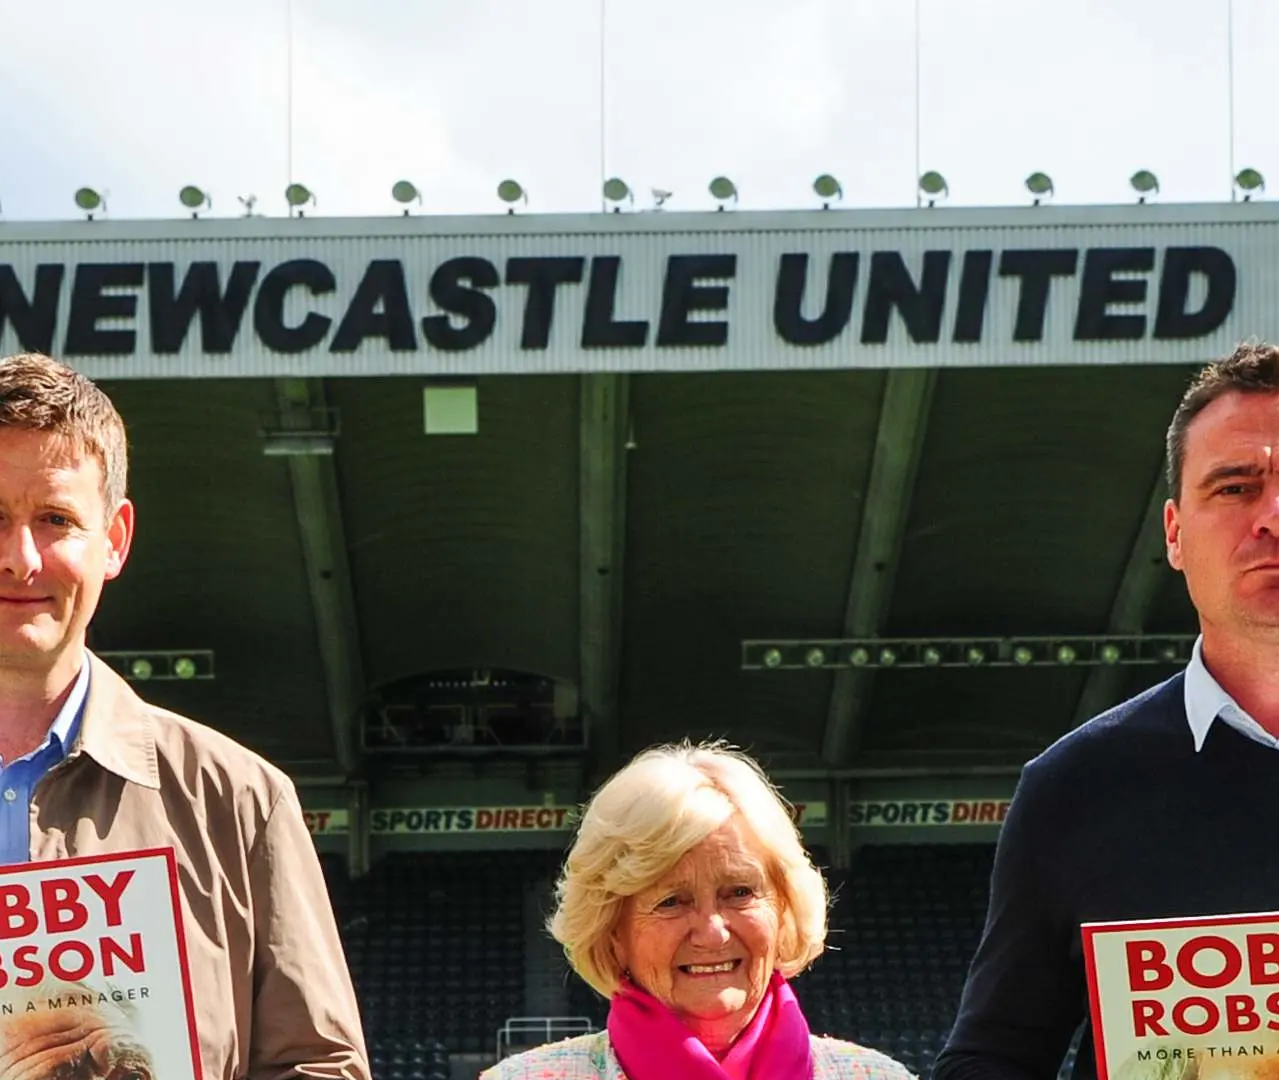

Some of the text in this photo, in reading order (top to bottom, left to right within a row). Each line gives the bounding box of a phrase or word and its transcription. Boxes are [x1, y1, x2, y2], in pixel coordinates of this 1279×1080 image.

[771, 245, 1237, 348] UNITED
[25, 1001, 37, 1014] A
[48, 988, 150, 1011] MANAGER
[1137, 1048, 1195, 1061] MORE
[1208, 1044, 1265, 1057] THAN
